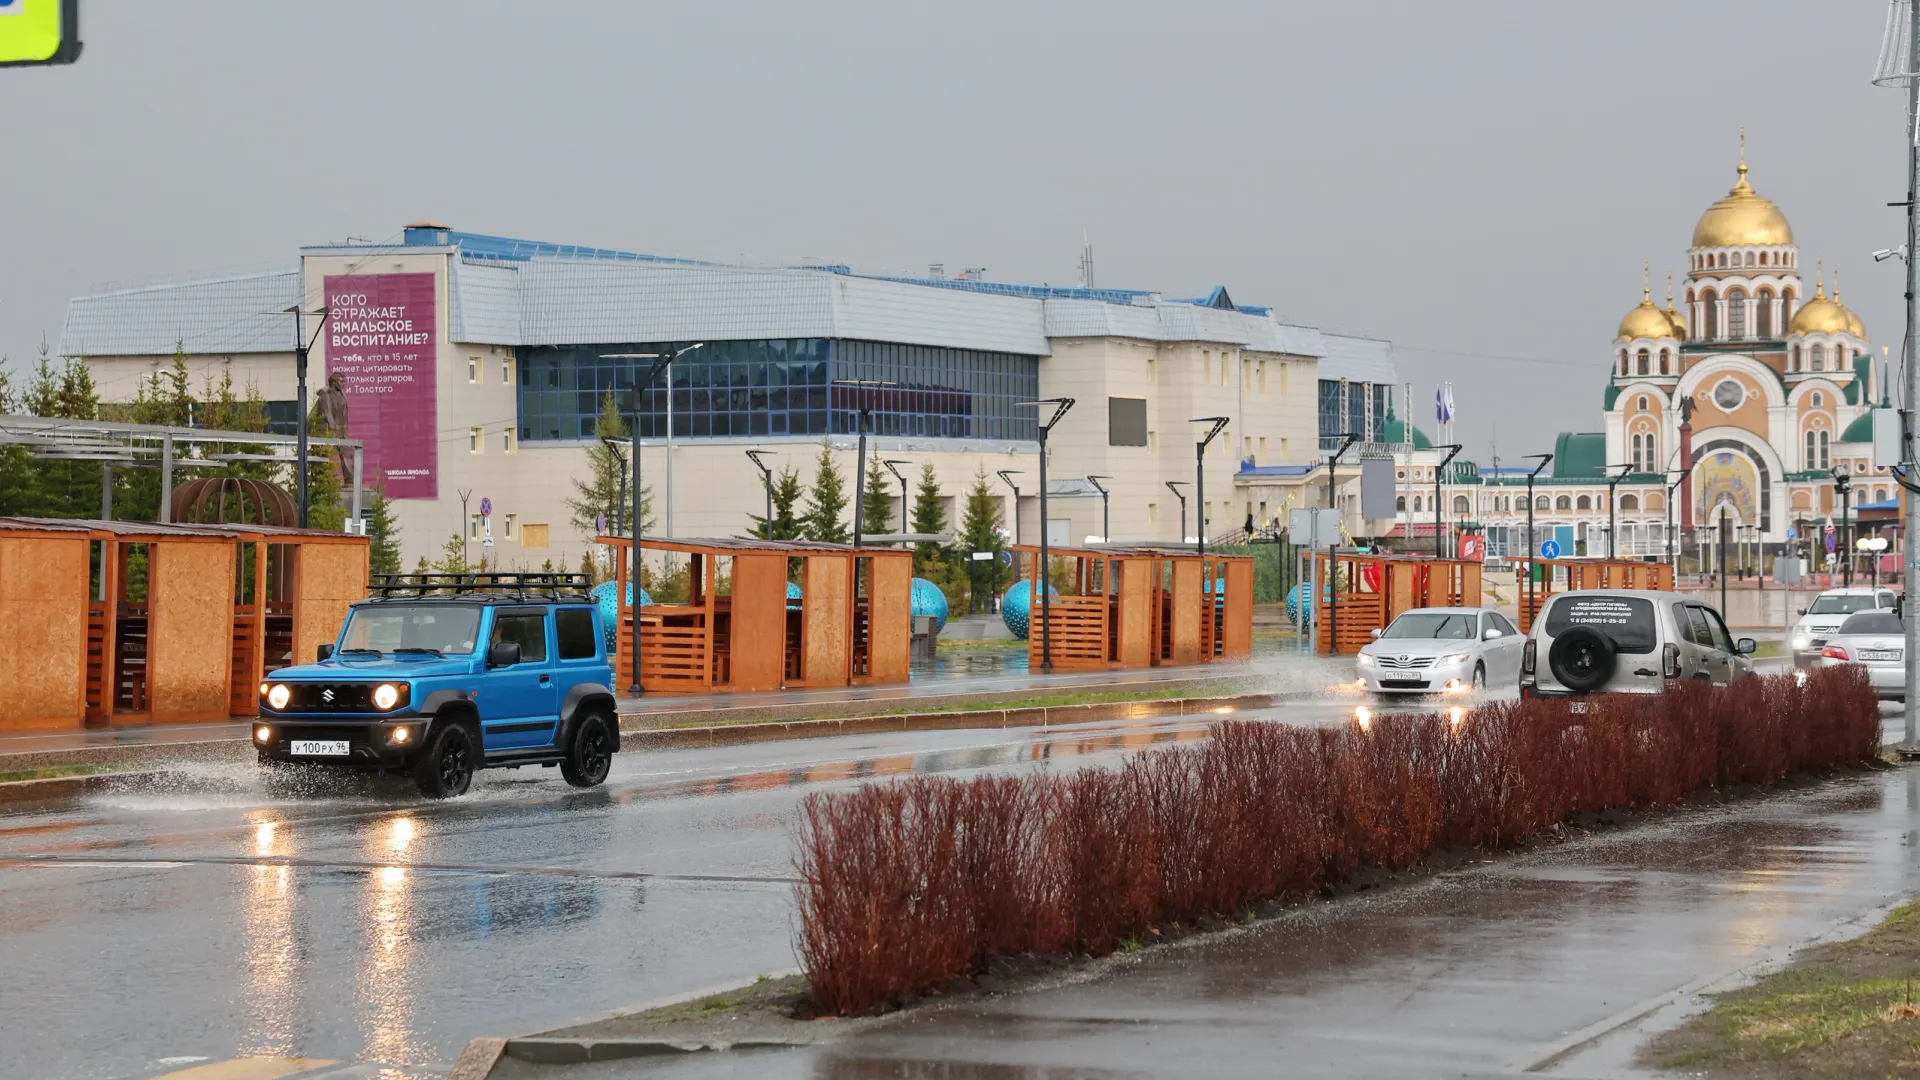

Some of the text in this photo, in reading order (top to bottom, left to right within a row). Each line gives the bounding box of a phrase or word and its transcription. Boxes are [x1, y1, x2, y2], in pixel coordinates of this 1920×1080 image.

[332, 294, 367, 306] КОГО
[332, 306, 406, 320] ОТРАЖАЕТ
[332, 320, 413, 333] ЯМАЛЬСКОЕ
[332, 333, 429, 347] ВОСПИТАНИЕ?
[343, 354, 364, 363] тебя,
[392, 352, 401, 361] 15
[403, 353, 418, 361] лет
[362, 364, 413, 373] цитировать
[345, 374, 415, 384] только рэперов,
[354, 385, 393, 393] Толстого
